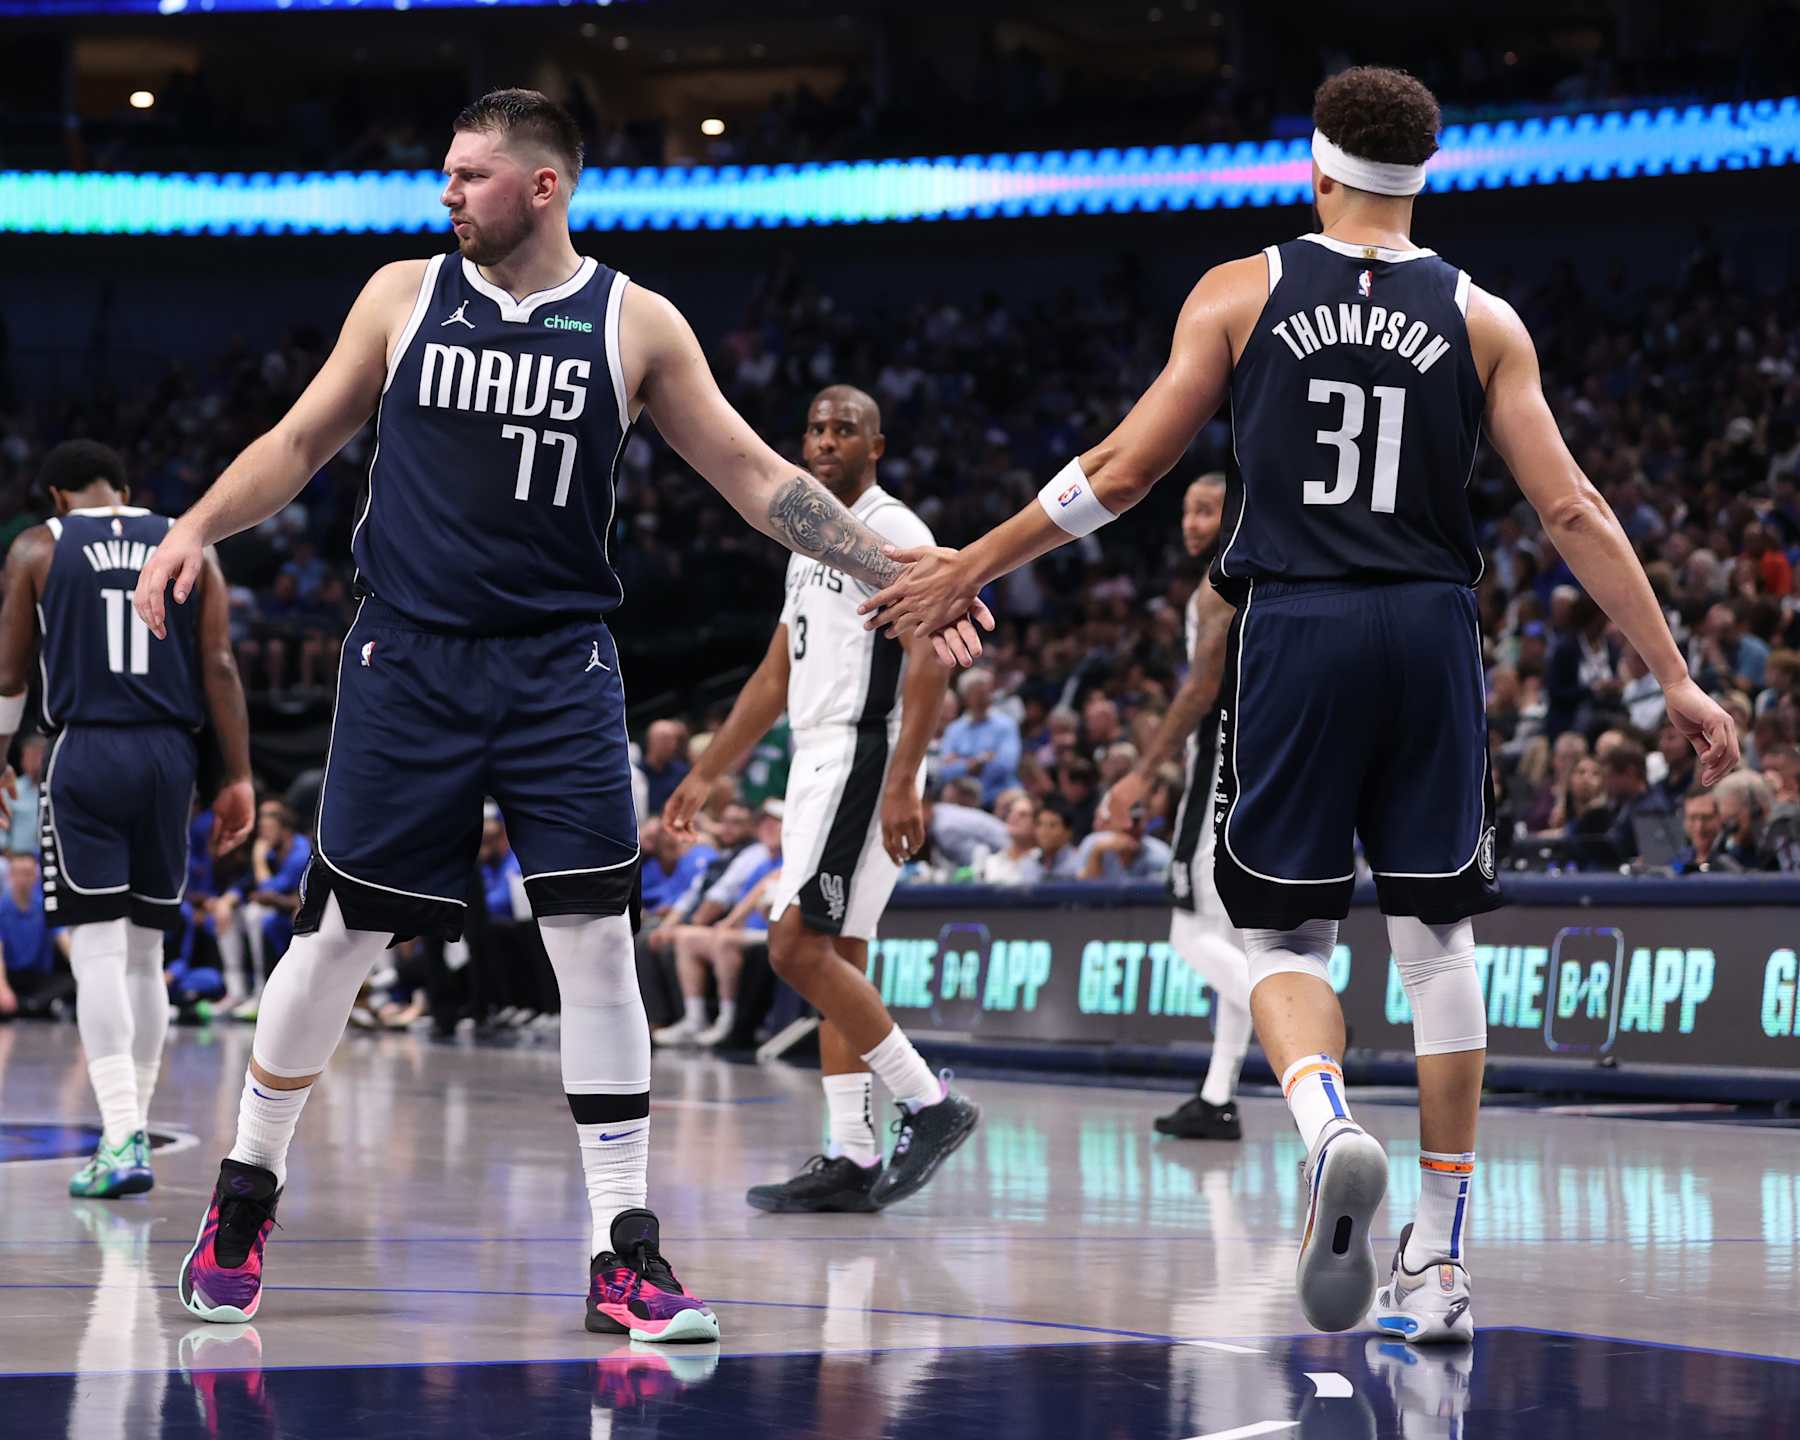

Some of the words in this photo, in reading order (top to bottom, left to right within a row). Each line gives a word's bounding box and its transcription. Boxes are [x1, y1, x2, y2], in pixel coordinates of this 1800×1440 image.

[544, 315, 592, 332] chime
[1272, 303, 1450, 374] THOMPSON
[419, 343, 591, 421] MAVS
[501, 424, 577, 507] 77
[1303, 378, 1406, 513] 31
[83, 540, 157, 571] IRVIN
[101, 588, 149, 675] 11
[794, 614, 808, 661] 3
[982, 940, 1052, 1011] APP
[1079, 940, 1147, 1015] GET
[1619, 947, 1716, 1034] APP
